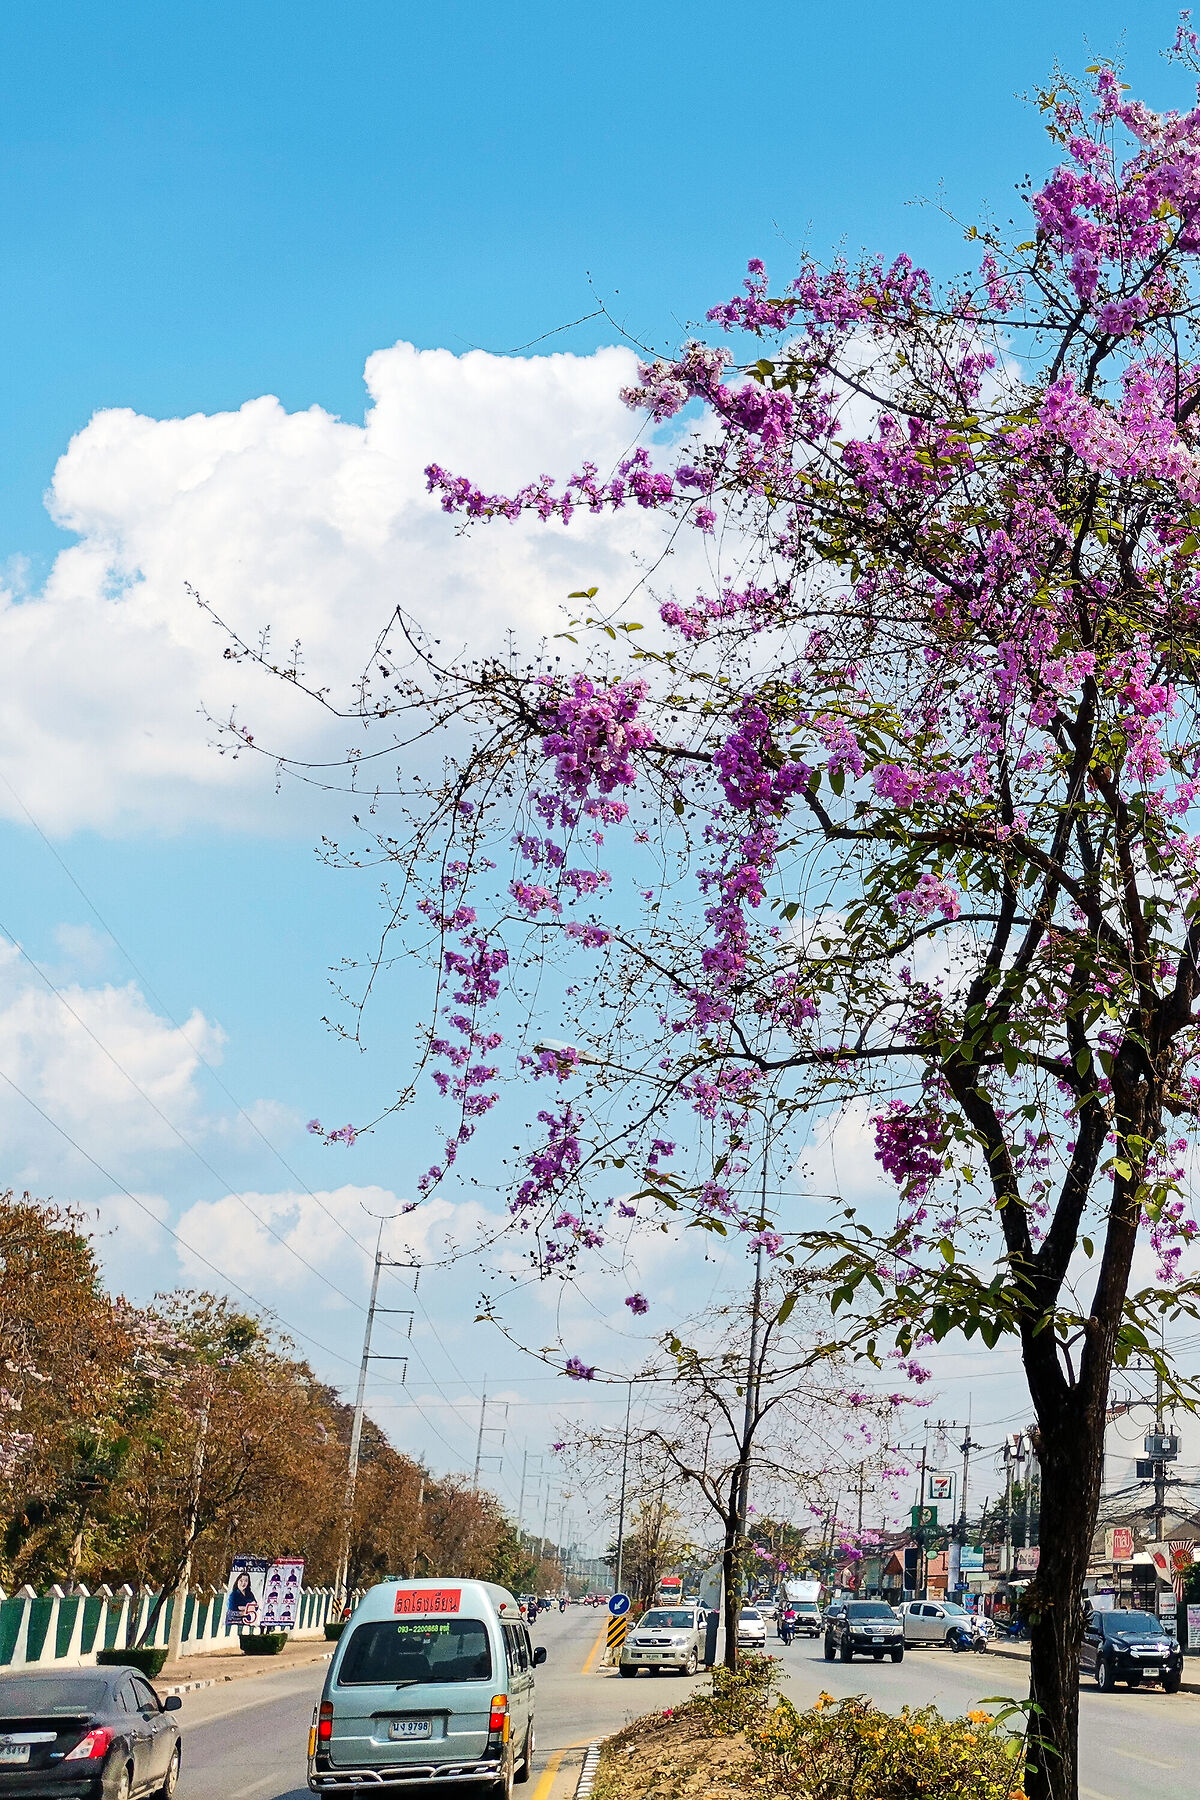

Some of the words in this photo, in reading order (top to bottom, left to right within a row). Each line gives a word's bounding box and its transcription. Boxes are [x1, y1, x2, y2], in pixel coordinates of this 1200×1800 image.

[396, 1591, 458, 1613] รถโรงเรียน
[243, 1603, 258, 1624] 5
[408, 1721, 428, 1731] 9798
